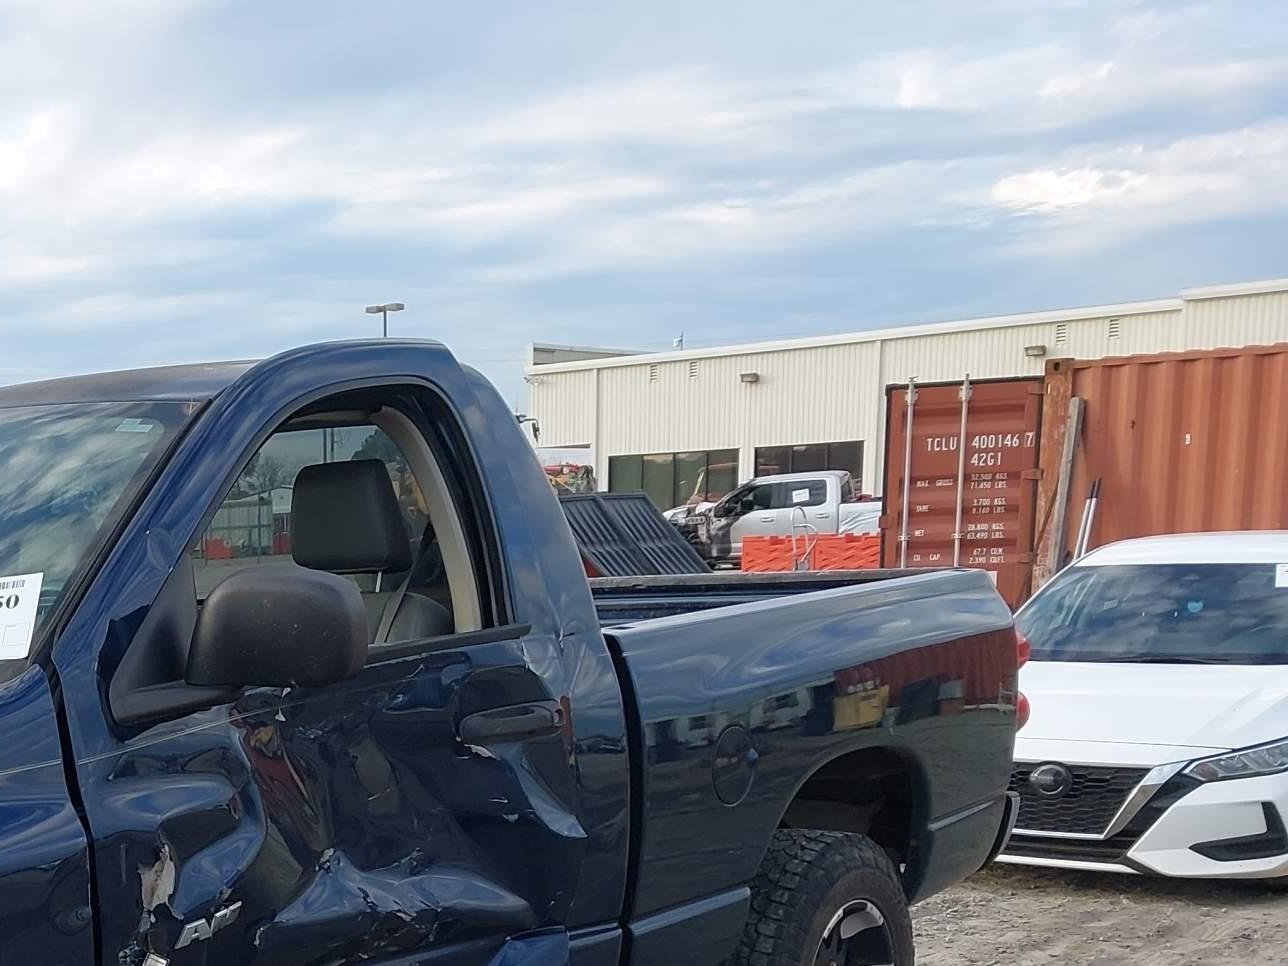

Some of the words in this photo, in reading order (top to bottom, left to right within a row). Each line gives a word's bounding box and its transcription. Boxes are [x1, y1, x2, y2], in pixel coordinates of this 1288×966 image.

[927, 437, 957, 451] TCLU
[972, 434, 1020, 449] 400146
[1026, 432, 1035, 447] 7
[971, 452, 1002, 466] 42G1
[914, 529, 925, 537] NET
